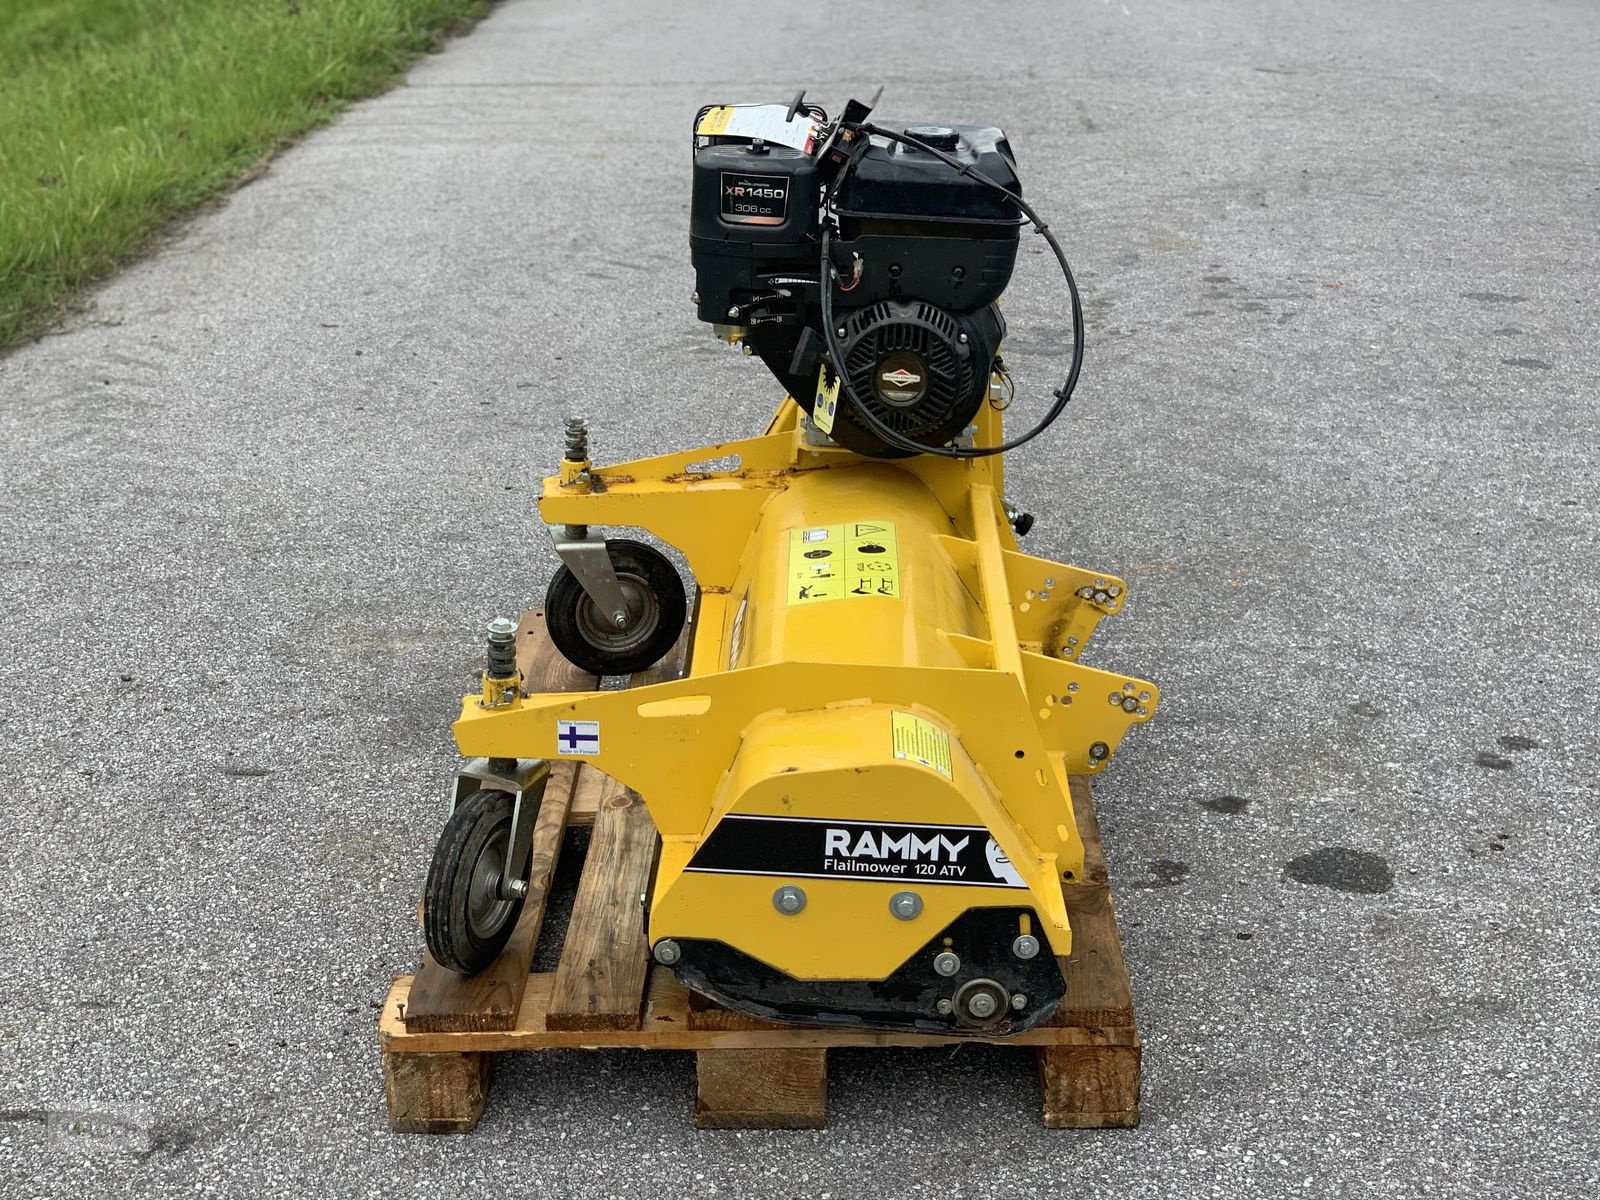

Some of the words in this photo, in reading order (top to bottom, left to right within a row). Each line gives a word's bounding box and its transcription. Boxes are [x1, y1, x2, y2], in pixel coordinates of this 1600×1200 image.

[725, 186, 784, 199] XR1450
[735, 204, 757, 213] 306
[824, 828, 970, 862] RAMMY
[824, 858, 907, 874] Flailmower
[914, 863, 936, 875] 120
[939, 865, 967, 877] ATV
